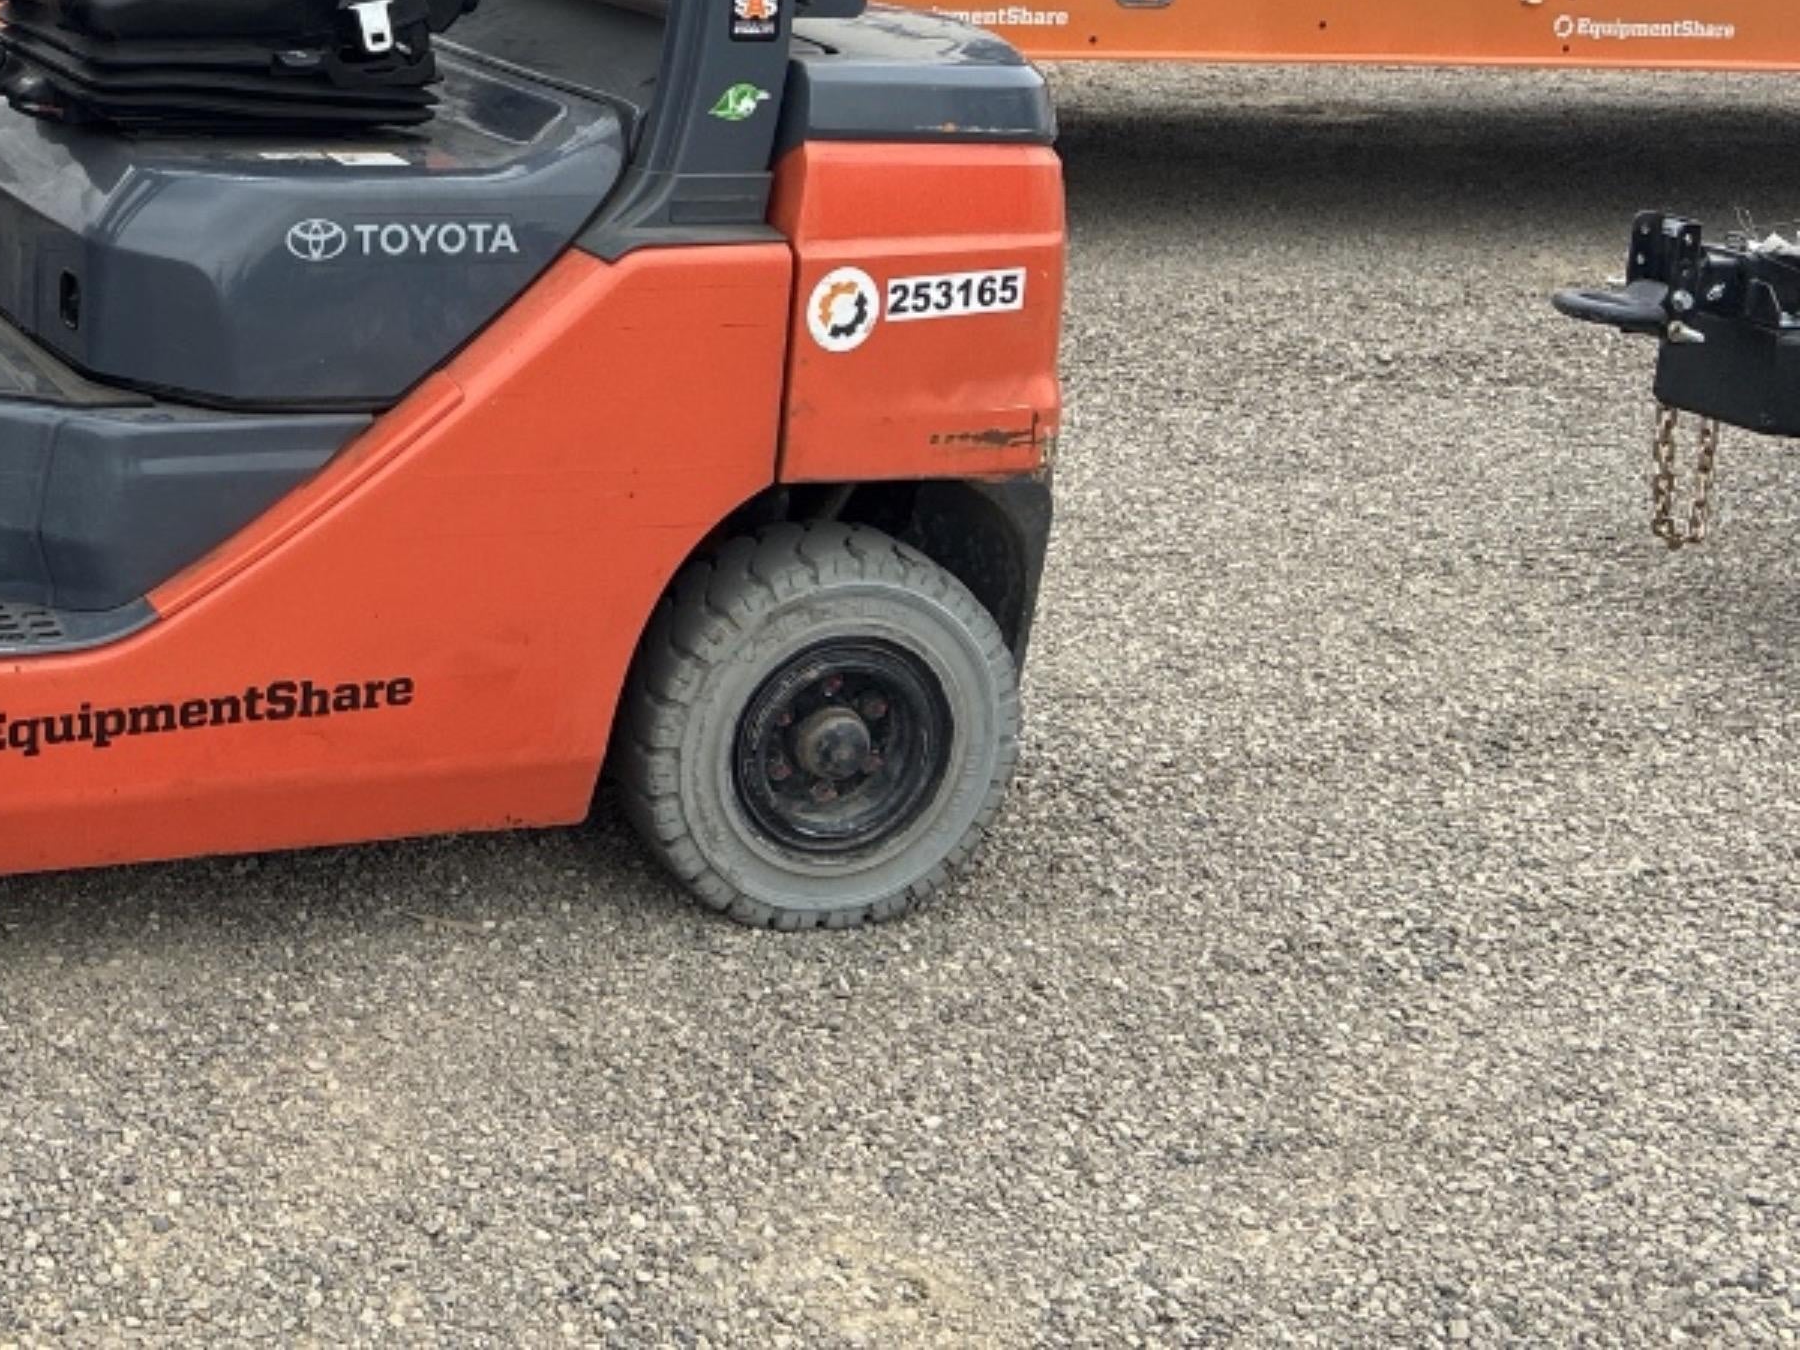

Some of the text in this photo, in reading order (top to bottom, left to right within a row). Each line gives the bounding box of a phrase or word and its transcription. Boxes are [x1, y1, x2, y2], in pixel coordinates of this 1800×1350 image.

[1576, 17, 1736, 40] EquipmentShare
[353, 223, 520, 255] TOYOTA
[888, 274, 1018, 314] 253165
